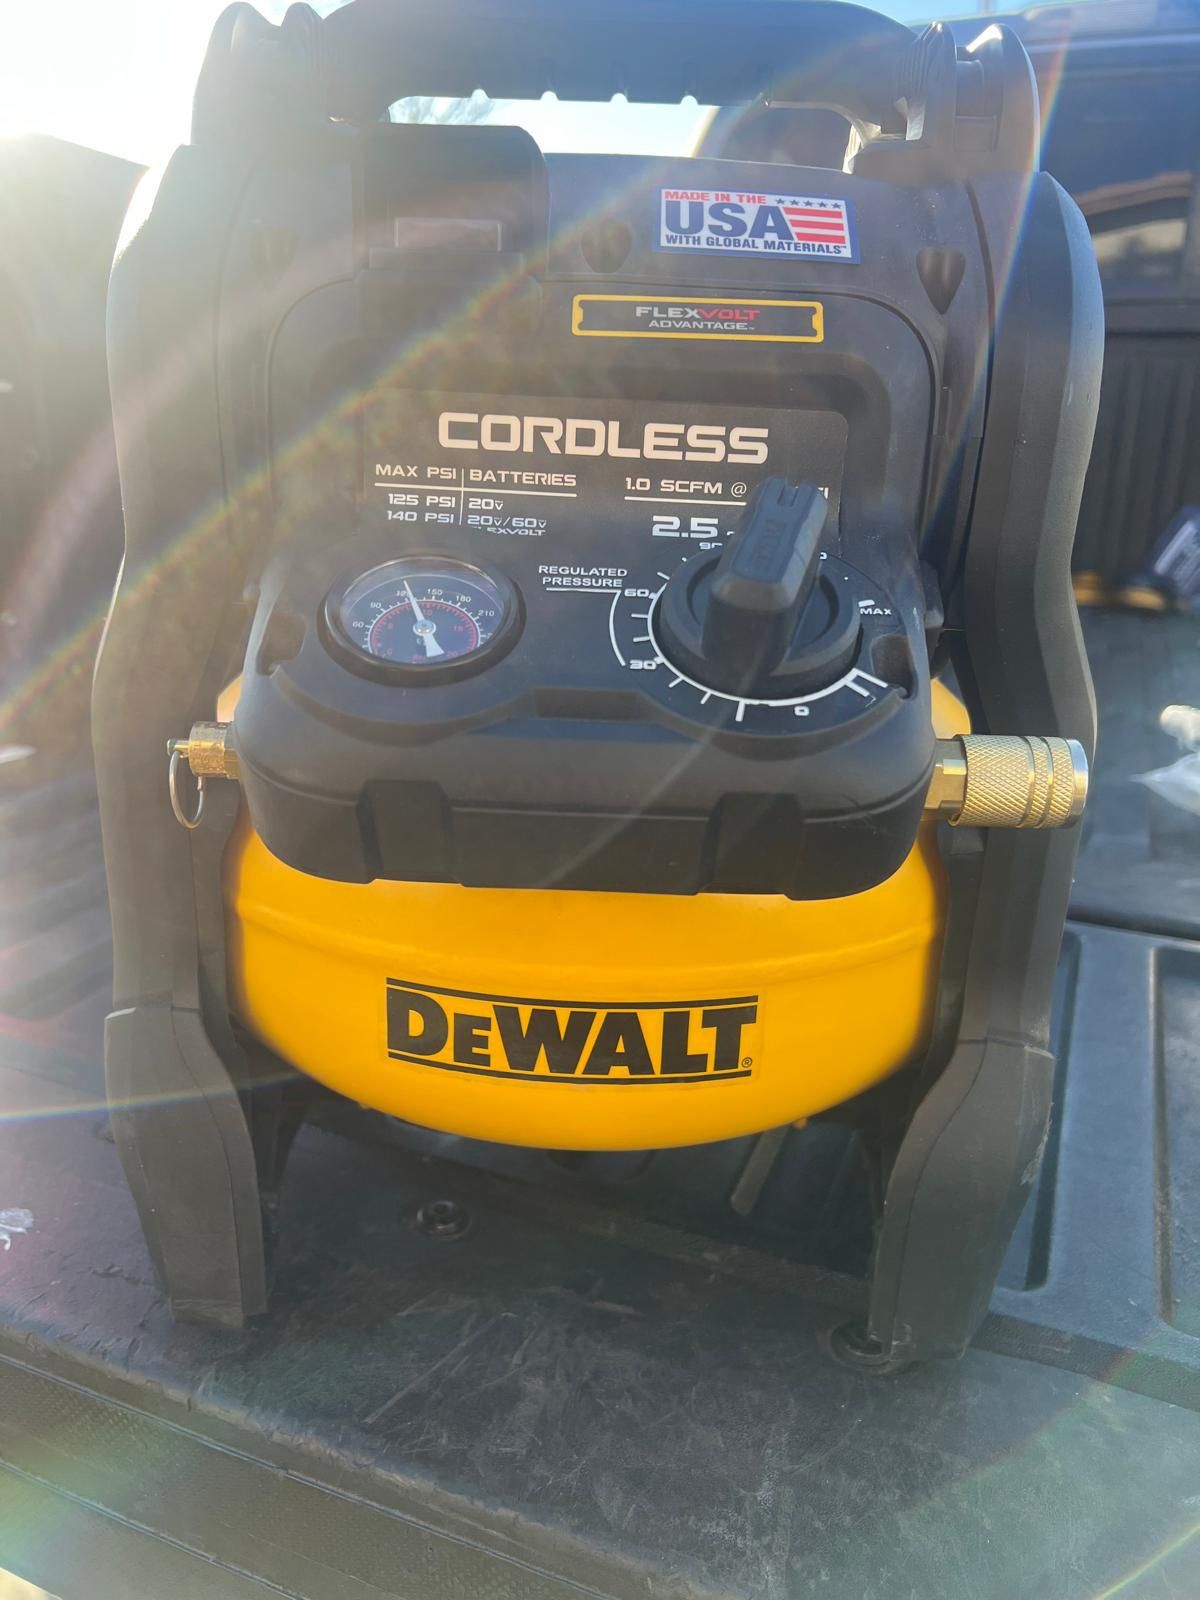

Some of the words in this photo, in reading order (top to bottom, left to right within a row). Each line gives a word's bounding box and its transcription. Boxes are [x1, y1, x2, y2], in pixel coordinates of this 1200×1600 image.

[664, 191, 710, 201] MADE
[715, 193, 731, 202] IN
[736, 195, 766, 204] THE
[665, 200, 794, 241] USA
[666, 235, 700, 245] WITH
[706, 237, 758, 249] GLOBAL
[635, 306, 760, 321] FLEXVOLT
[438, 412, 769, 464] CORDLESS
[375, 464, 418, 477] MAX
[427, 467, 456, 479] PSI
[469, 469, 577, 486] BATTERIES
[625, 477, 650, 491] 1.0
[660, 480, 722, 494] SCFM
[731, 482, 747, 497] @
[388, 493, 419, 506] 125
[426, 496, 455, 508] PSI
[387, 511, 417, 521] 140
[425, 513, 454, 524] PSI
[652, 515, 719, 538] 2.5
[538, 566, 627, 576] REGULATED
[543, 577, 622, 587] PRESSURE
[427, 588, 443, 596] 150
[624, 589, 649, 597] 60
[456, 595, 471, 603] 180
[860, 607, 892, 615] MAX
[630, 660, 656, 670] 30
